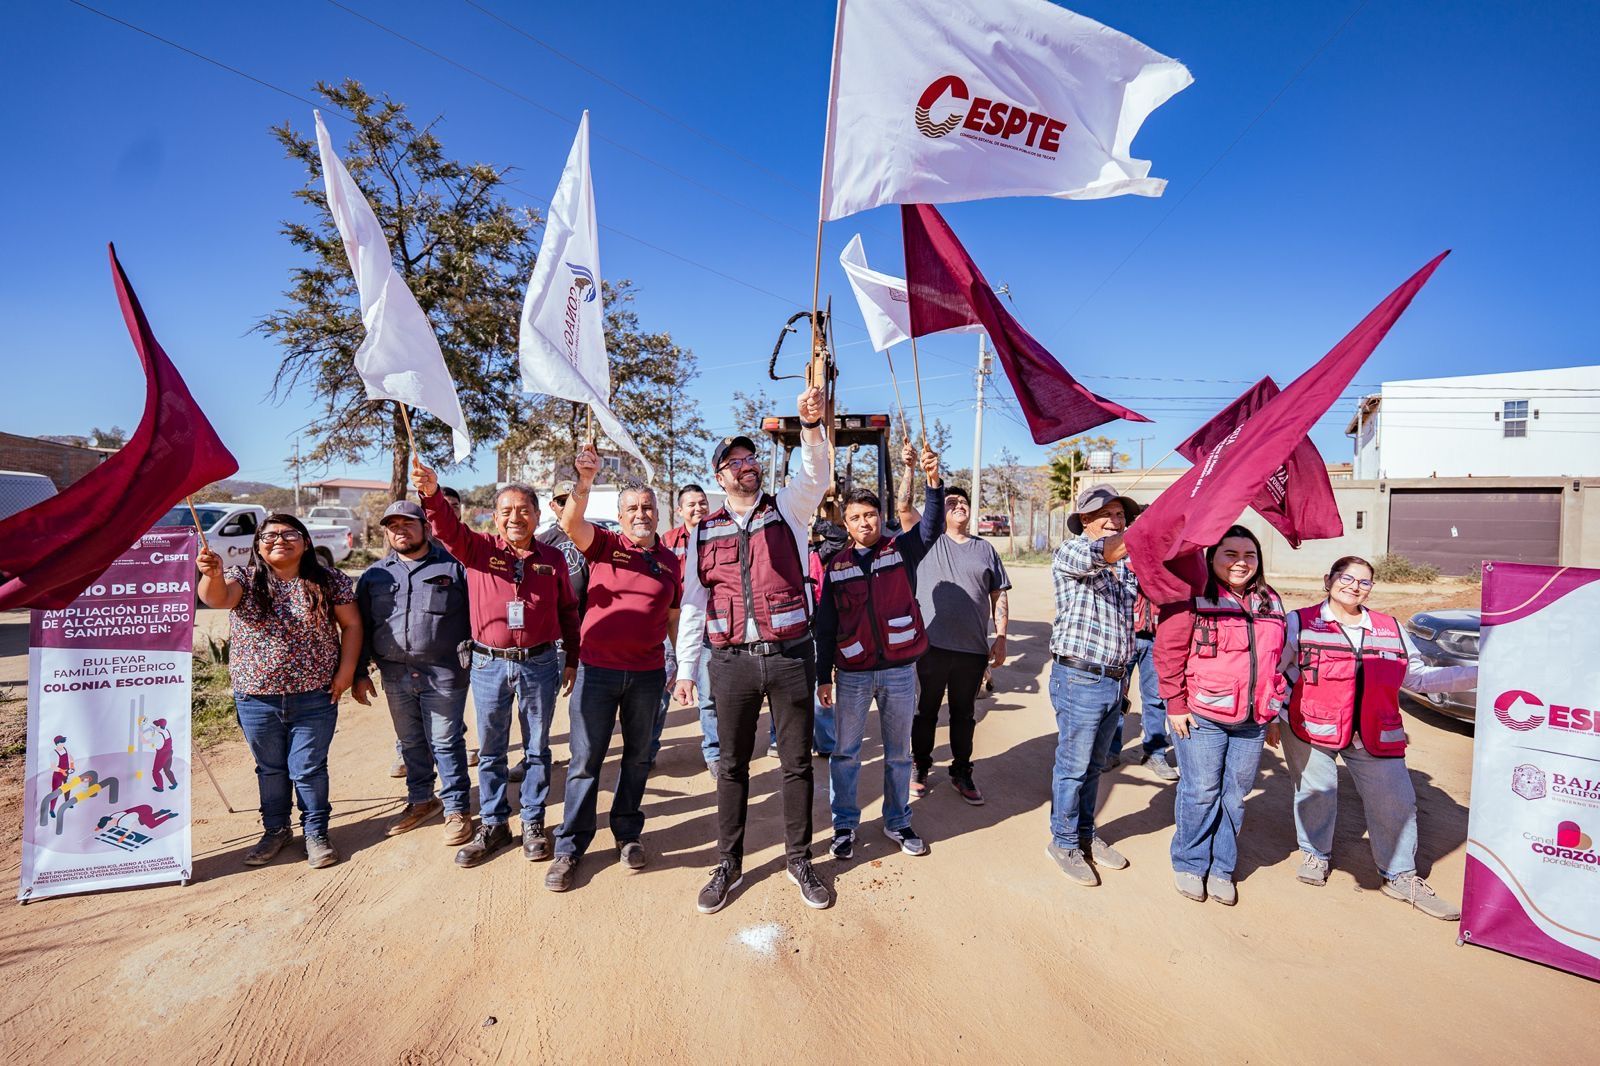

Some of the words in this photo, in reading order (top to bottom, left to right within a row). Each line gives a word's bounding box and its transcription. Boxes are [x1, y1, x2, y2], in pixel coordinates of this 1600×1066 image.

[111, 583, 137, 595] DE
[142, 581, 191, 593] OBRA
[44, 604, 137, 619] AMPLIACIÓN
[141, 604, 159, 614] DE
[162, 603, 189, 613] RED
[42, 619, 58, 629] DE
[62, 613, 190, 628] ALCANTARILLADO
[64, 625, 147, 639] SANITARIO
[150, 625, 171, 634] EN:
[83, 655, 147, 667] BULEVAR
[54, 666, 108, 678] FAMILIA
[112, 662, 176, 674] FEDERICO
[43, 680, 111, 693] COLONIA
[115, 675, 185, 688] ESCORIAL
[1523, 832, 1544, 842] Con
[54, 867, 84, 875] PROGRAMA
[143, 856, 174, 865] CUALQUIER
[151, 863, 182, 871] PROGRAMA
